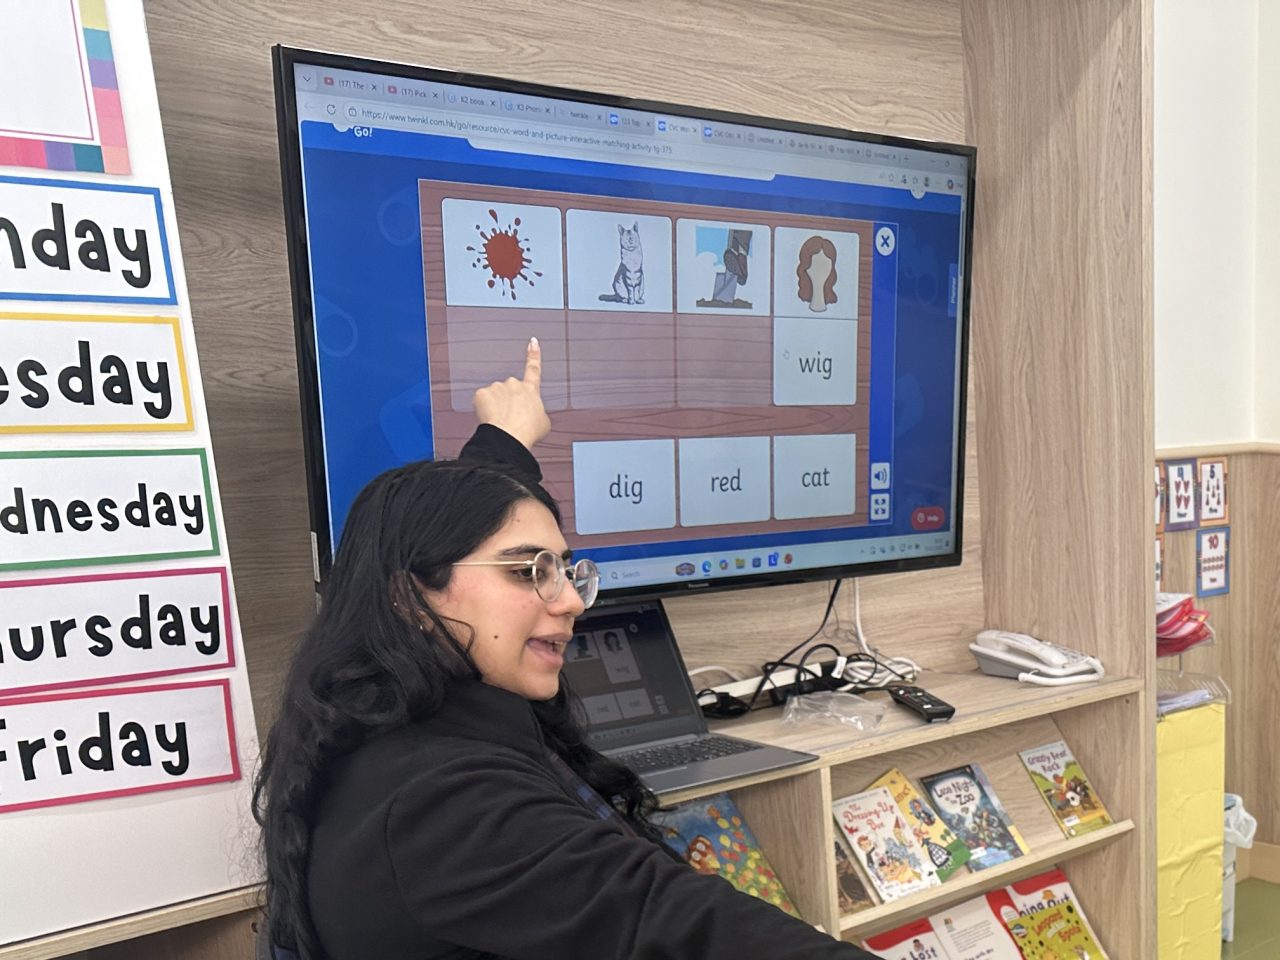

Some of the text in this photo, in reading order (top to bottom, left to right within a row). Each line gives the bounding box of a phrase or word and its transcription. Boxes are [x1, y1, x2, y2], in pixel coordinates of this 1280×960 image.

[353, 126, 373, 137] Go!
[0, 340, 172, 420] sday
[799, 351, 833, 380] wig
[0, 483, 205, 536] dnesday
[608, 467, 831, 505] dig red cat
[0, 594, 221, 663] ursday
[0, 711, 191, 782] riday
